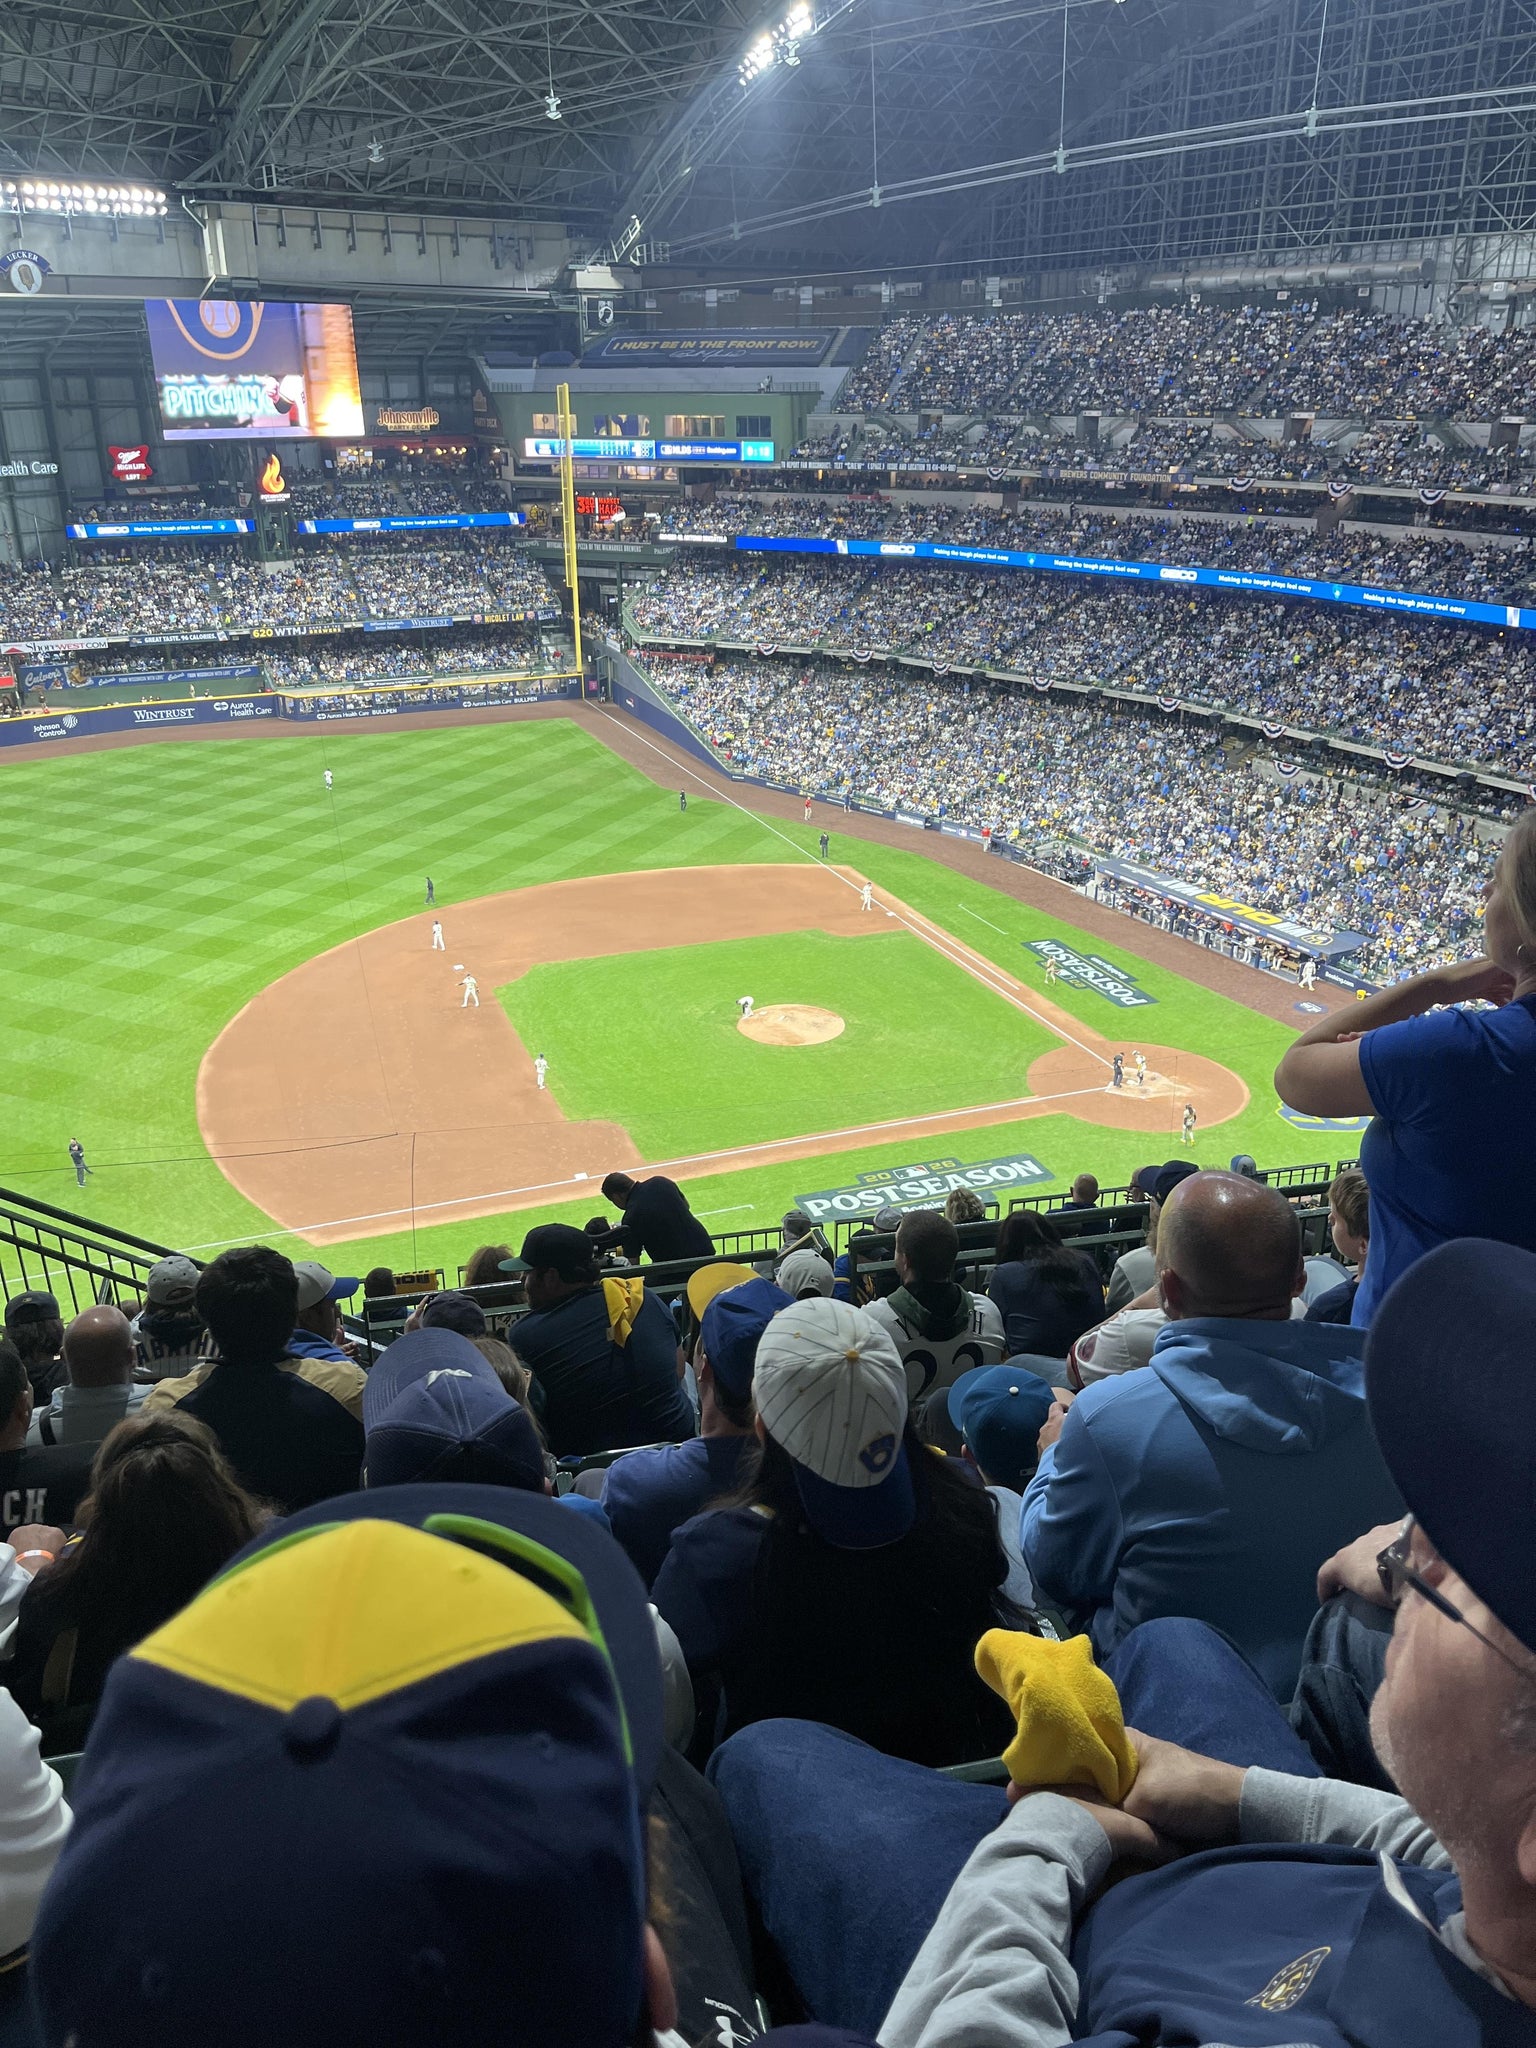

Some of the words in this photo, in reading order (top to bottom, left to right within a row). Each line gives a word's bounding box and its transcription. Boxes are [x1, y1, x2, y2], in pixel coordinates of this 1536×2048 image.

[6, 251, 39, 262] UECKER
[613, 342, 620, 350] I
[620, 341, 660, 350] MUST
[659, 340, 679, 349] BE
[680, 340, 696, 349] IN
[700, 340, 729, 349] THE
[728, 340, 773, 349] FRONT
[777, 340, 819, 349] ROW!
[377, 407, 439, 426] Johnsonville
[0, 461, 29, 477] ealth
[31, 461, 58, 475] Care
[599, 497, 620, 505] MARKET
[934, 548, 950, 557] Making
[959, 551, 973, 559] tough
[973, 552, 986, 560] plays
[1054, 559, 1073, 568] Making
[1083, 562, 1099, 571] tough
[1218, 575, 1241, 585] Making
[1252, 579, 1271, 588] tough
[1271, 581, 1285, 589] plays
[1286, 582, 1298, 590] feel
[1298, 585, 1312, 593] easy
[1363, 592, 1386, 603] Making
[1386, 596, 1397, 604] the
[1397, 598, 1416, 609] tough
[1416, 600, 1434, 610] plays
[1435, 603, 1449, 612] feel
[1449, 606, 1466, 616] easy
[411, 618, 449, 627] WINTRUST
[485, 613, 510, 624] NICOLET
[511, 612, 524, 622] LAW
[144, 634, 163, 643] GREAT
[162, 634, 180, 642] TASTE.
[179, 633, 187, 641] 96
[187, 632, 217, 641] CALORIES.
[252, 629, 273, 638] 620
[274, 627, 307, 637] WTMJ
[25, 667, 63, 687] Culver's
[230, 701, 254, 709] Aurora
[471, 700, 486, 708] Aurora
[486, 699, 502, 707] Health
[514, 697, 538, 705] BULLPEN
[134, 707, 195, 720] WINTRUST
[230, 707, 255, 717] Health
[256, 707, 273, 716] Care
[326, 712, 342, 720] Aurora
[342, 711, 358, 719] Health
[372, 708, 398, 716] BULLPEN
[33, 722, 60, 733] Johnson
[39, 728, 67, 738] Controls
[1155, 878, 1207, 897] WAY
[1195, 891, 1283, 926] OUR
[1029, 940, 1148, 1006] POSTSEASON
[863, 1172, 892, 1183] 20
[803, 1159, 1044, 1218] POSTSEASON
